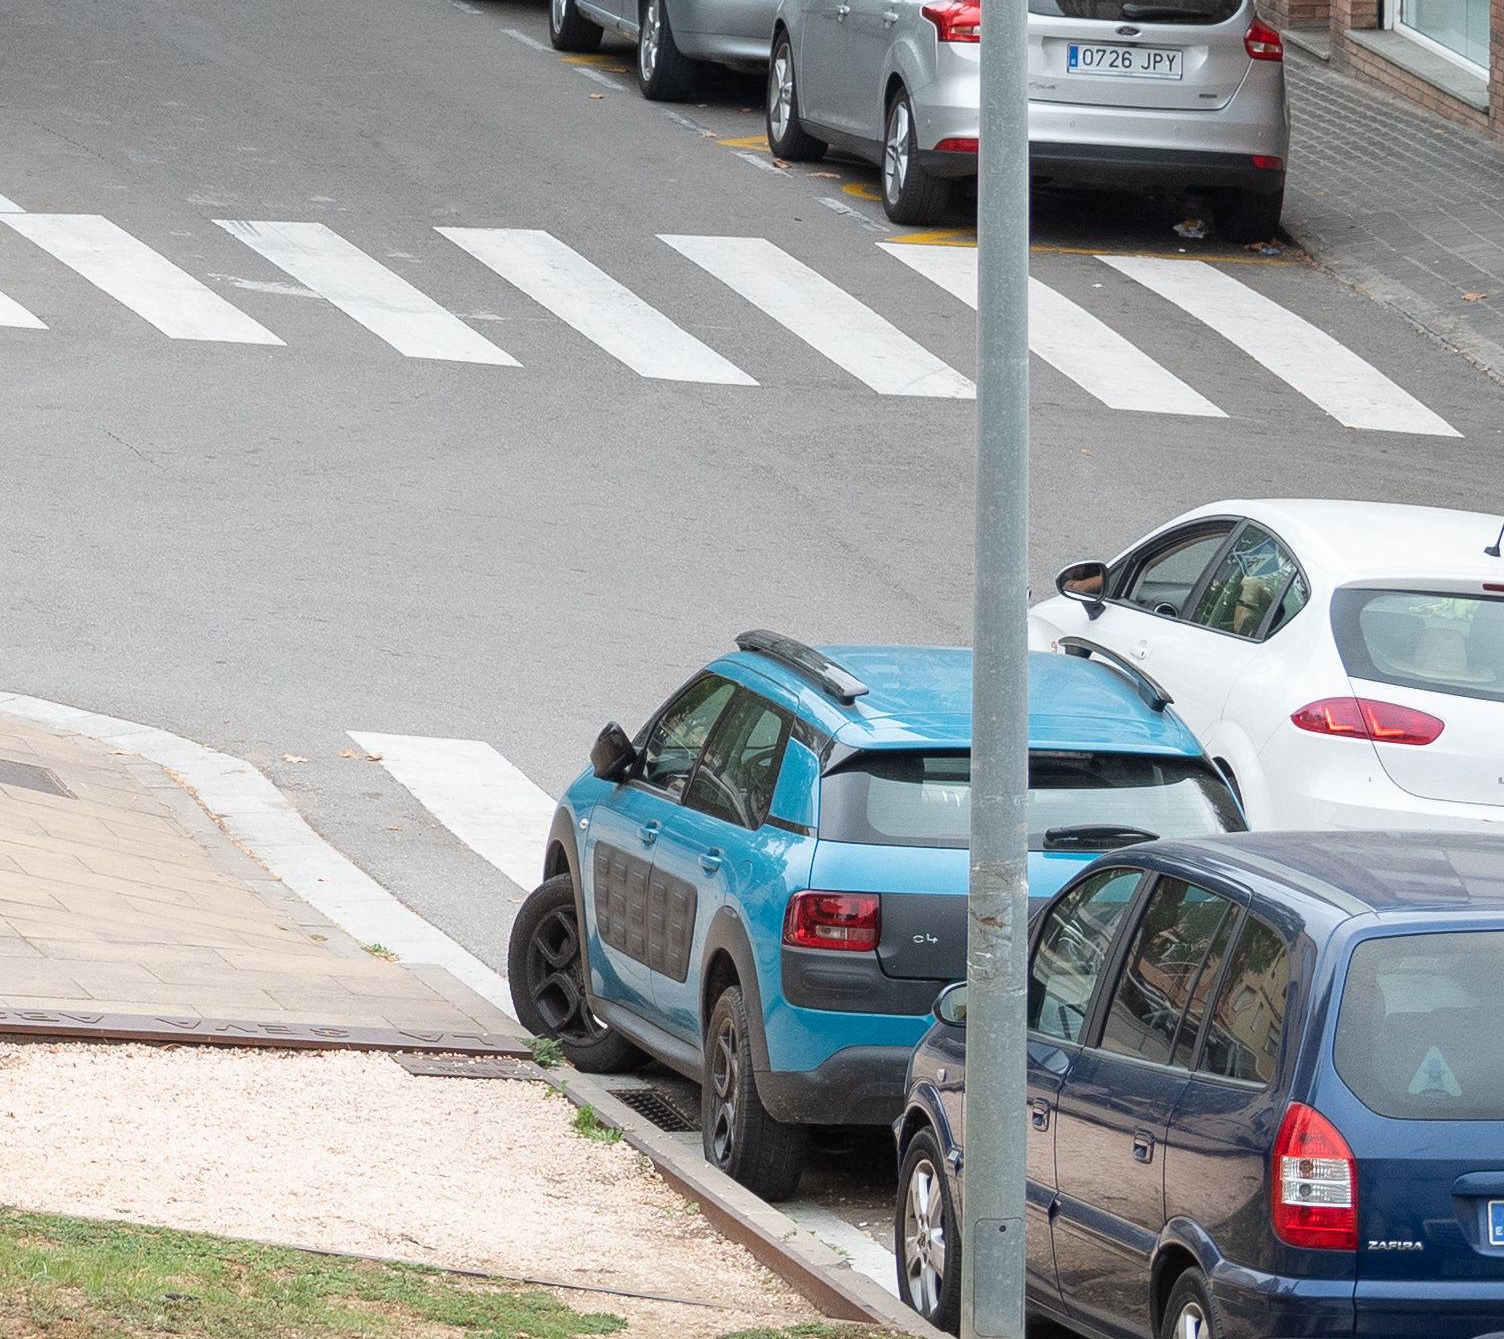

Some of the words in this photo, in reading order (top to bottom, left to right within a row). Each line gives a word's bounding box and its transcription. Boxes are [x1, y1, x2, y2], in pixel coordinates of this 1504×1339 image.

[1081, 48, 1133, 69] 0726
[1140, 52, 1177, 73] JPY
[1368, 1240, 1424, 1251] ZAFIRA
